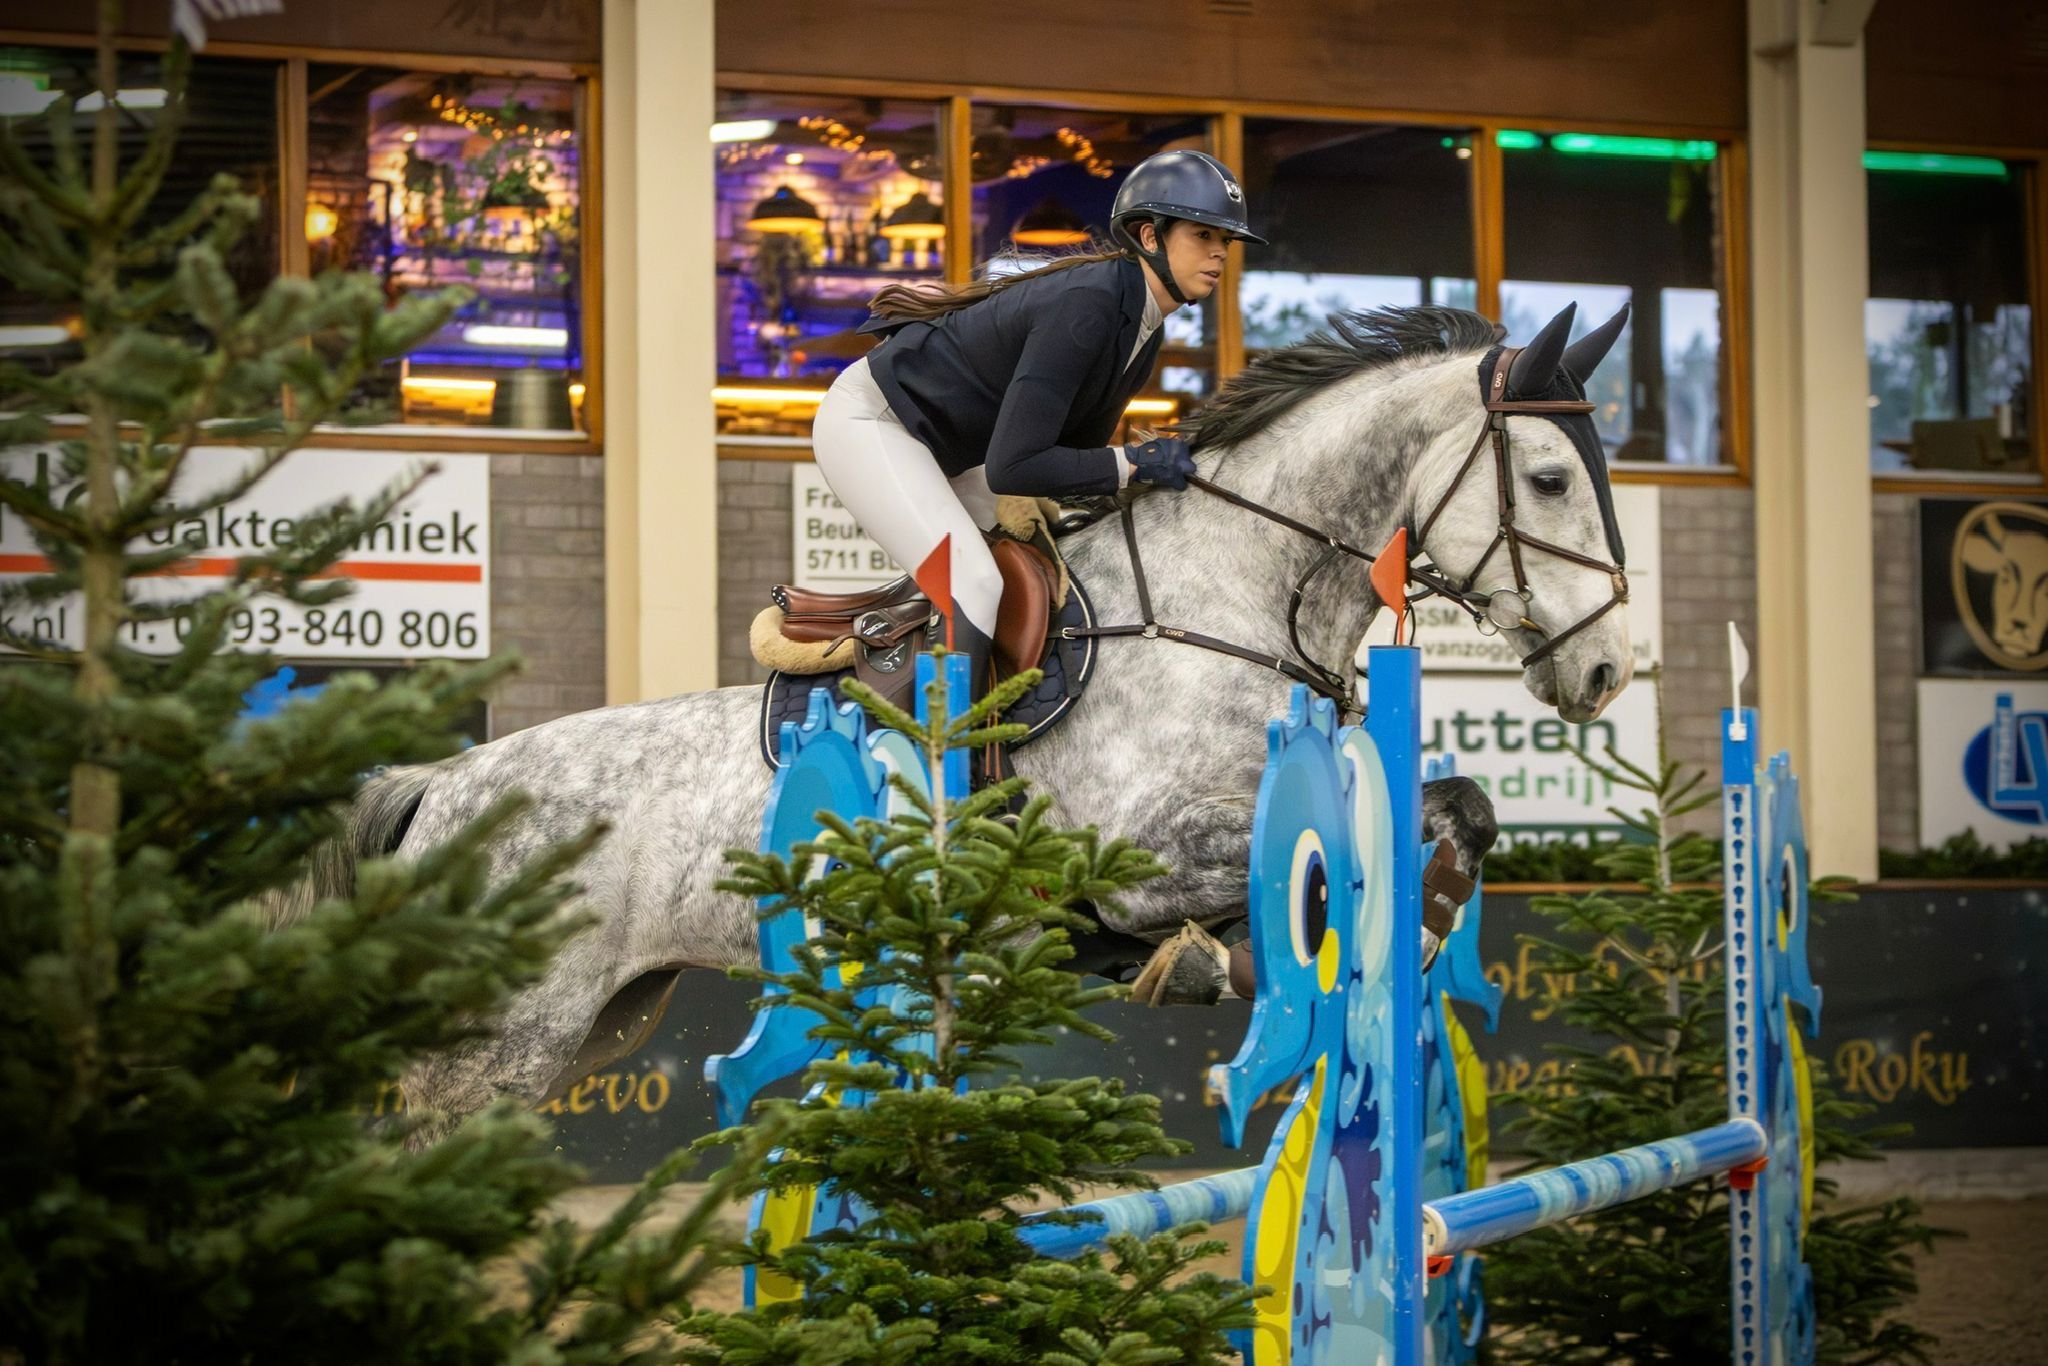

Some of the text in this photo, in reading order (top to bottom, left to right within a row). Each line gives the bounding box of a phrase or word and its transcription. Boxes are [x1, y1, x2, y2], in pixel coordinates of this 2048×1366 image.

[807, 550, 859, 570] 5711
[399, 611, 478, 649] 806
[1835, 1030, 1972, 1105] Roku
